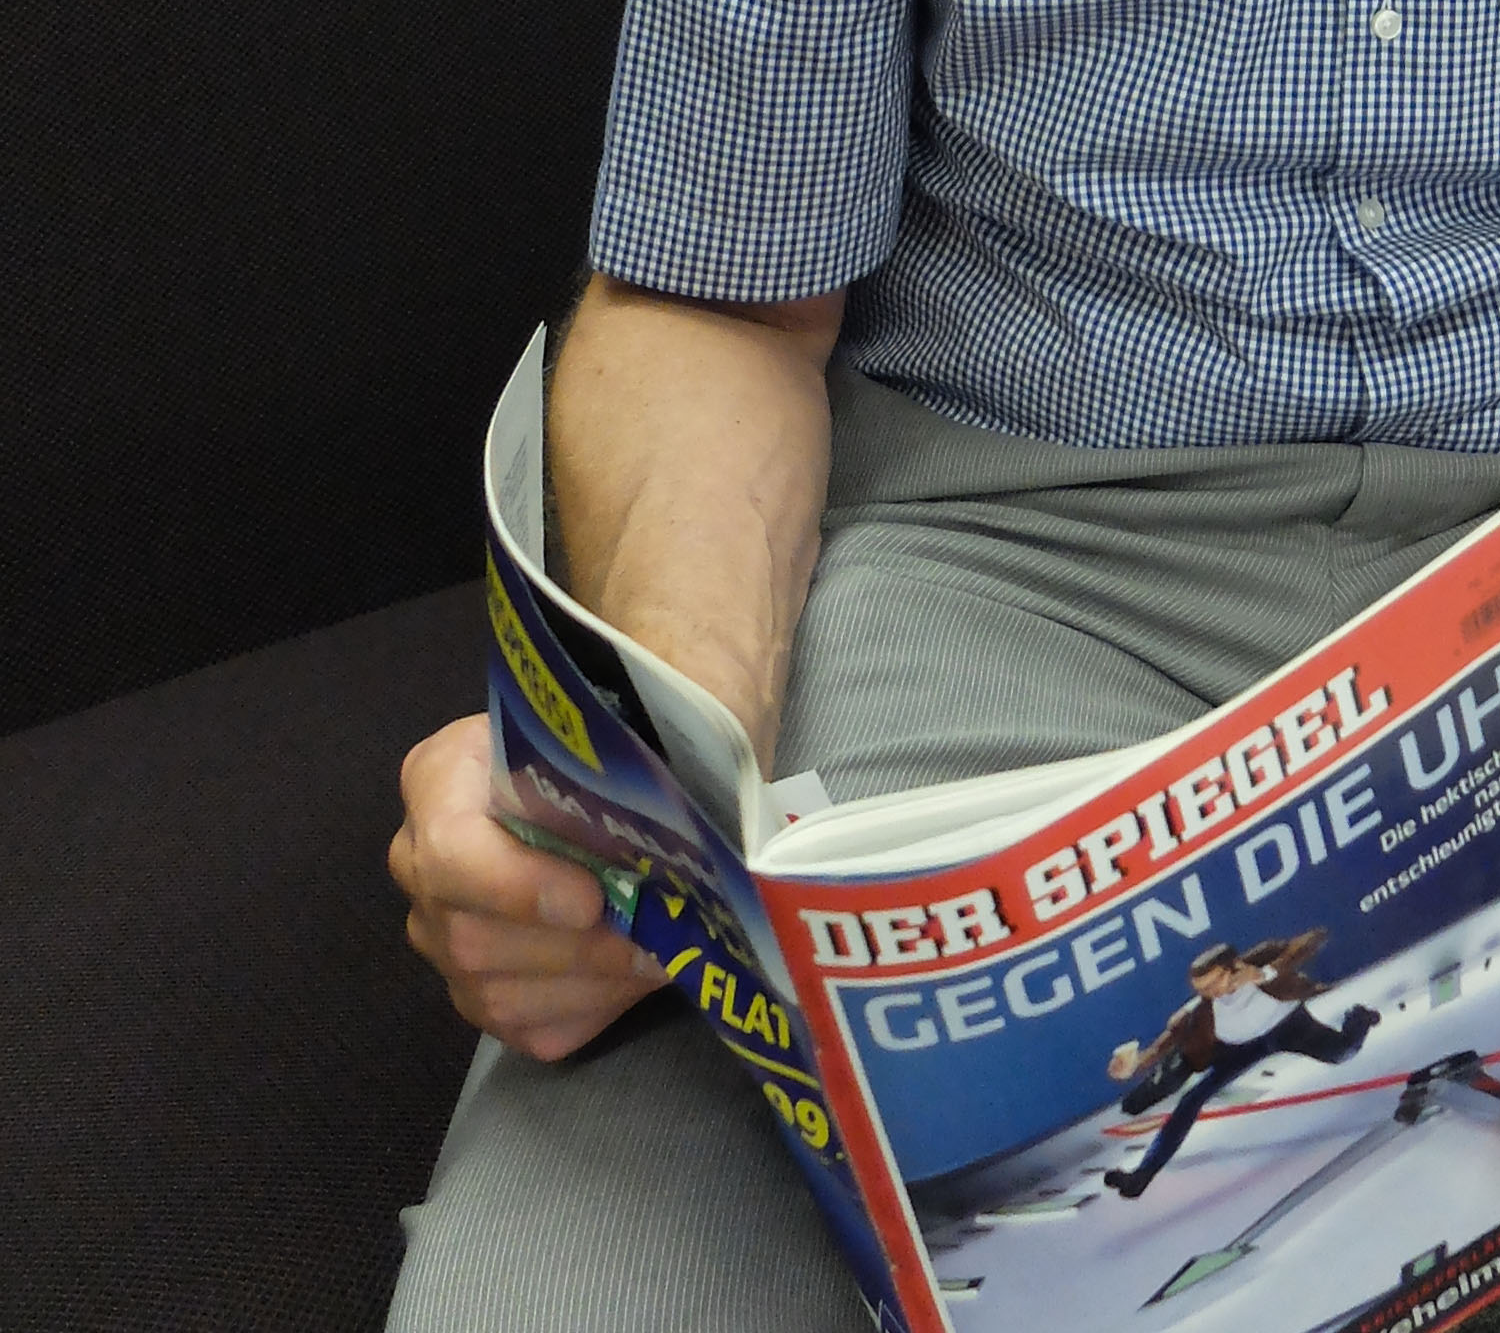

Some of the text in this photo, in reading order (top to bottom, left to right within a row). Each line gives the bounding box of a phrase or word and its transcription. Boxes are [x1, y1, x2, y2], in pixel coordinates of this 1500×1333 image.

[800, 664, 1393, 968] DER SPIEGEL
[865, 876, 1215, 1053] GEGEN
[1236, 765, 1383, 907] DIE
[1378, 818, 1418, 854] Die
[699, 963, 792, 1053] FLAT
